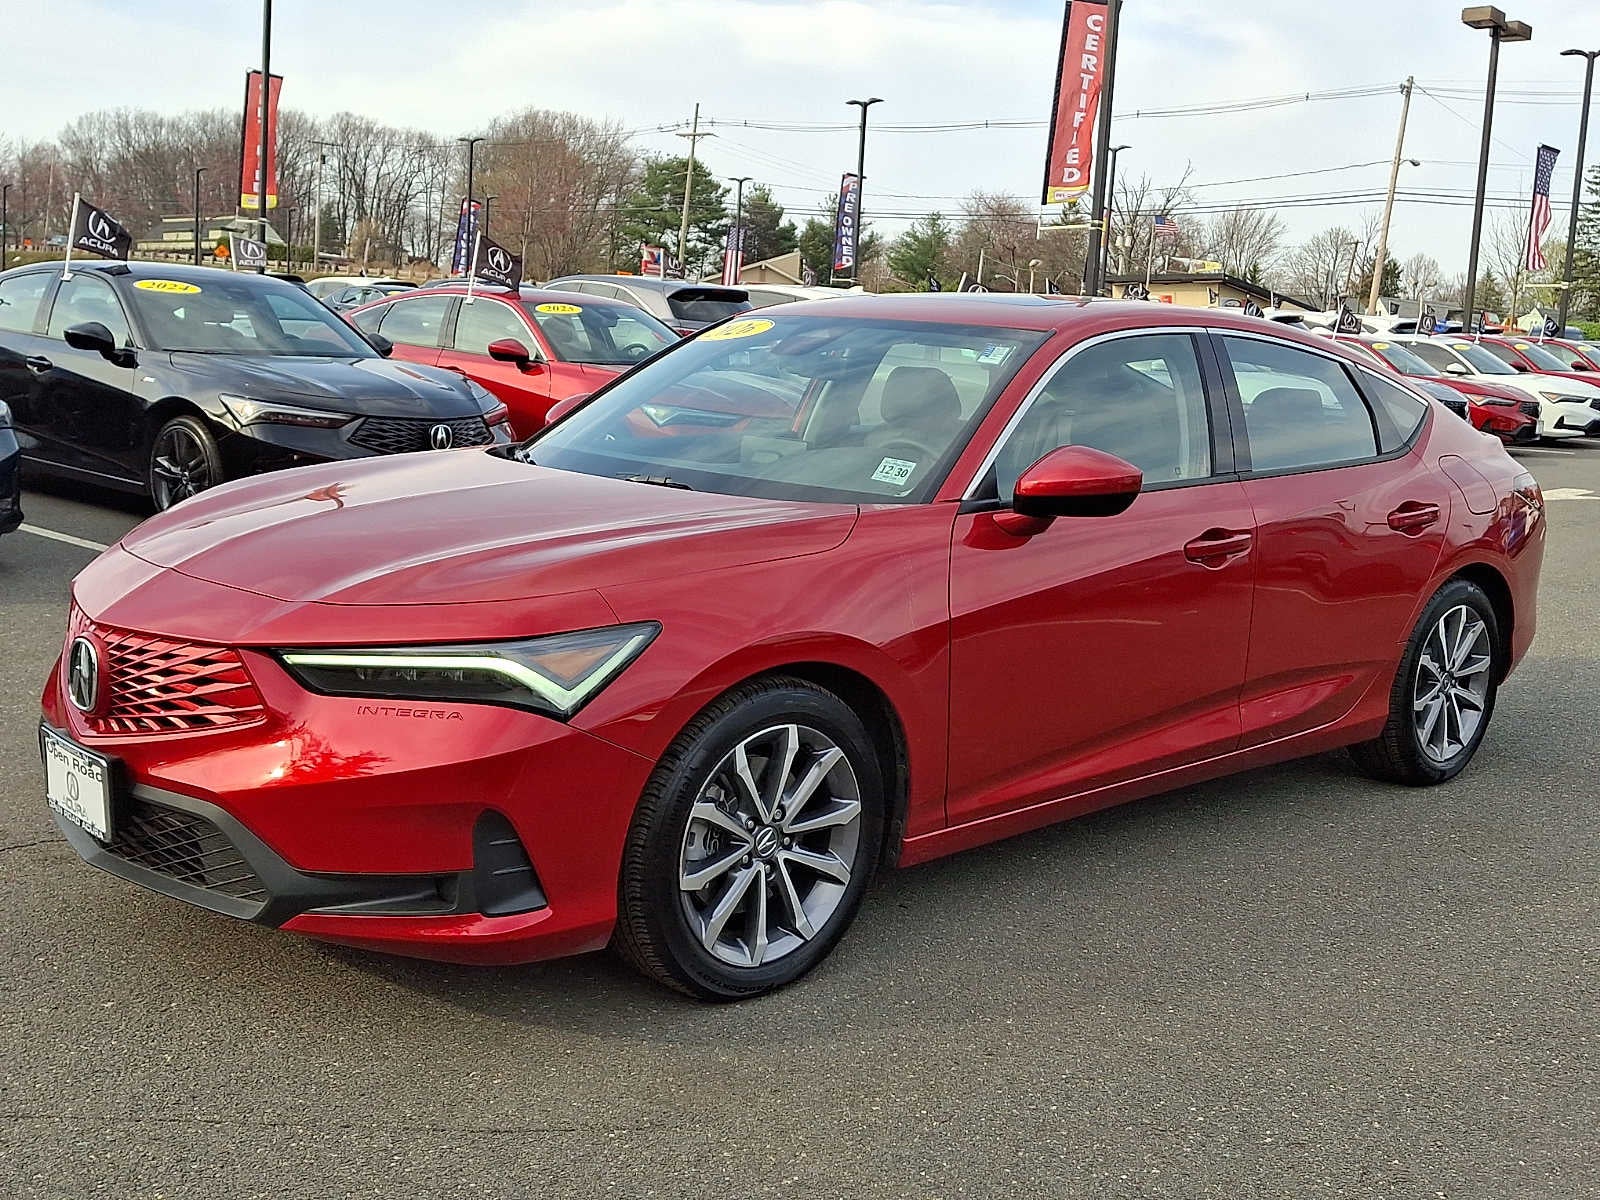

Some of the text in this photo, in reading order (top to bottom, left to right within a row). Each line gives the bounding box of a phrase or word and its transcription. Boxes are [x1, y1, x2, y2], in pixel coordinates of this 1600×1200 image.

[1062, 14, 1104, 183] CERTIFIED
[79, 236, 119, 257] ACURA
[146, 281, 190, 291] 2024
[481, 268, 513, 286] ACURA
[880, 464, 909, 478] 12 30
[357, 705, 464, 721] INTEGRA
[46, 739, 69, 767] Open
